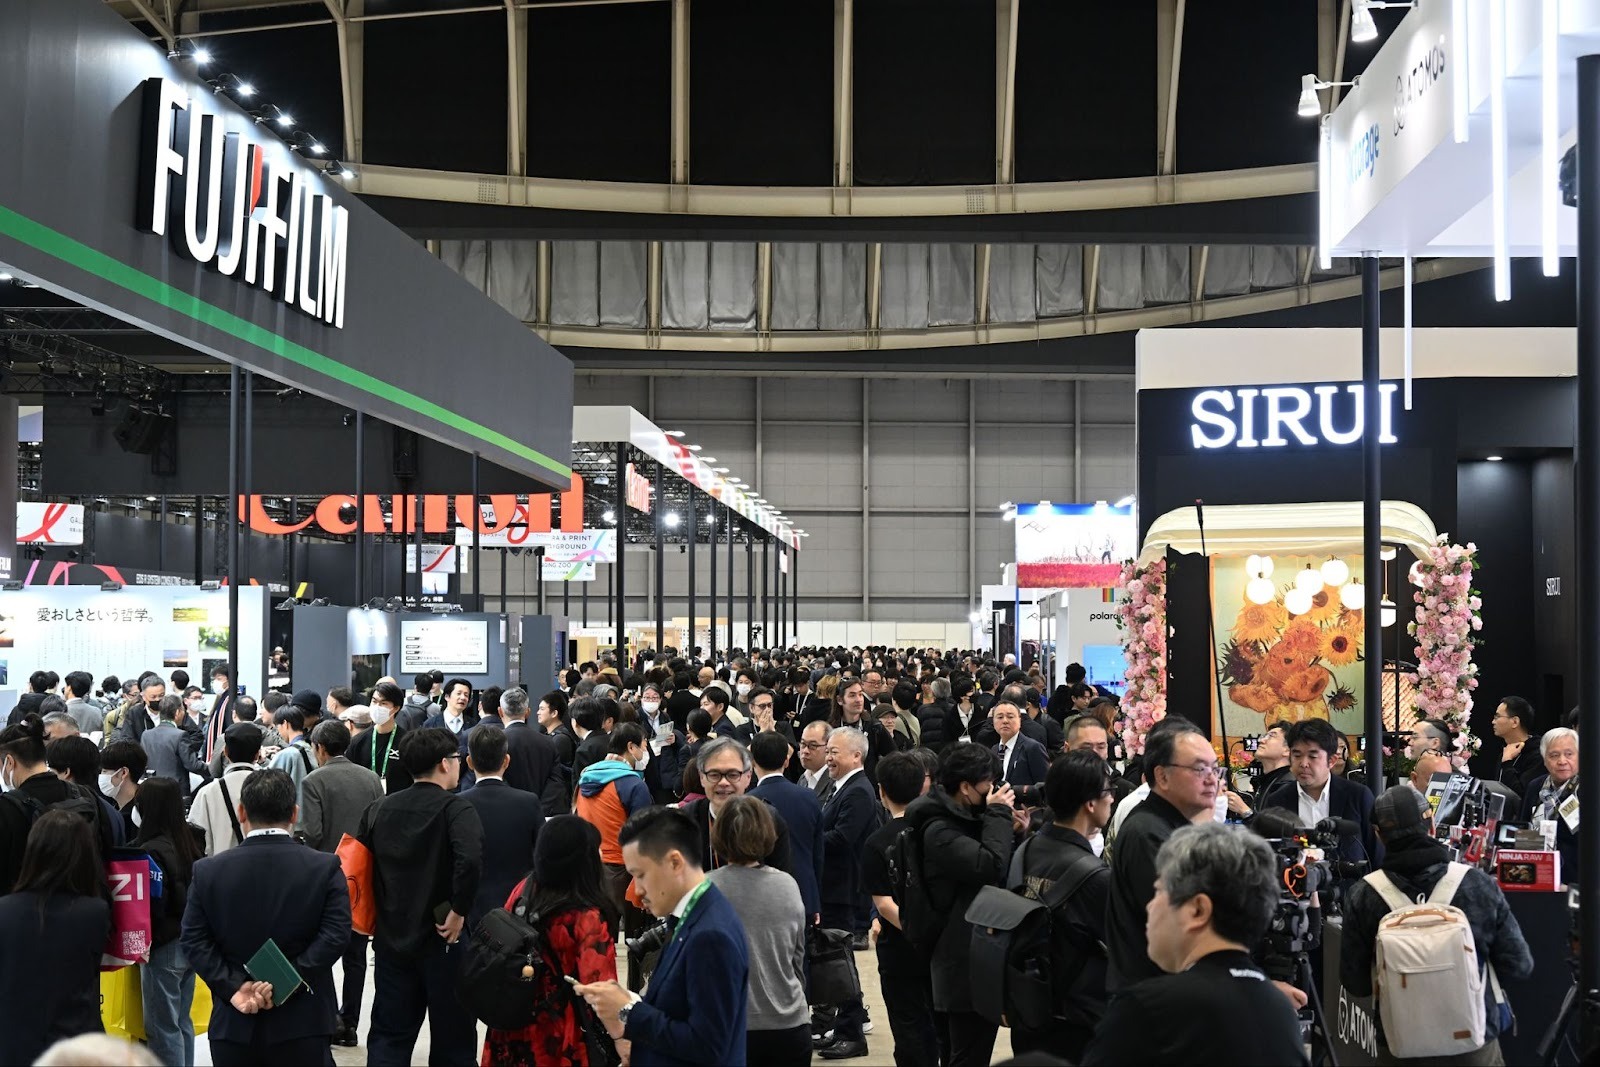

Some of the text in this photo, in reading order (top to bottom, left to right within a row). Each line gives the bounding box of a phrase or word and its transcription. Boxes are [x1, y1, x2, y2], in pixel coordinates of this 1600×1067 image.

[1407, 43, 1446, 104] ATOMOS
[150, 77, 349, 329] FUJIFILM
[1191, 383, 1398, 449] SIRUI
[1546, 576, 1561, 596] SIRUI
[37, 606, 154, 623] 愛おしさという哲学。
[1090, 611, 1127, 622] polarod
[1499, 853, 1543, 861] NINJA RAW
